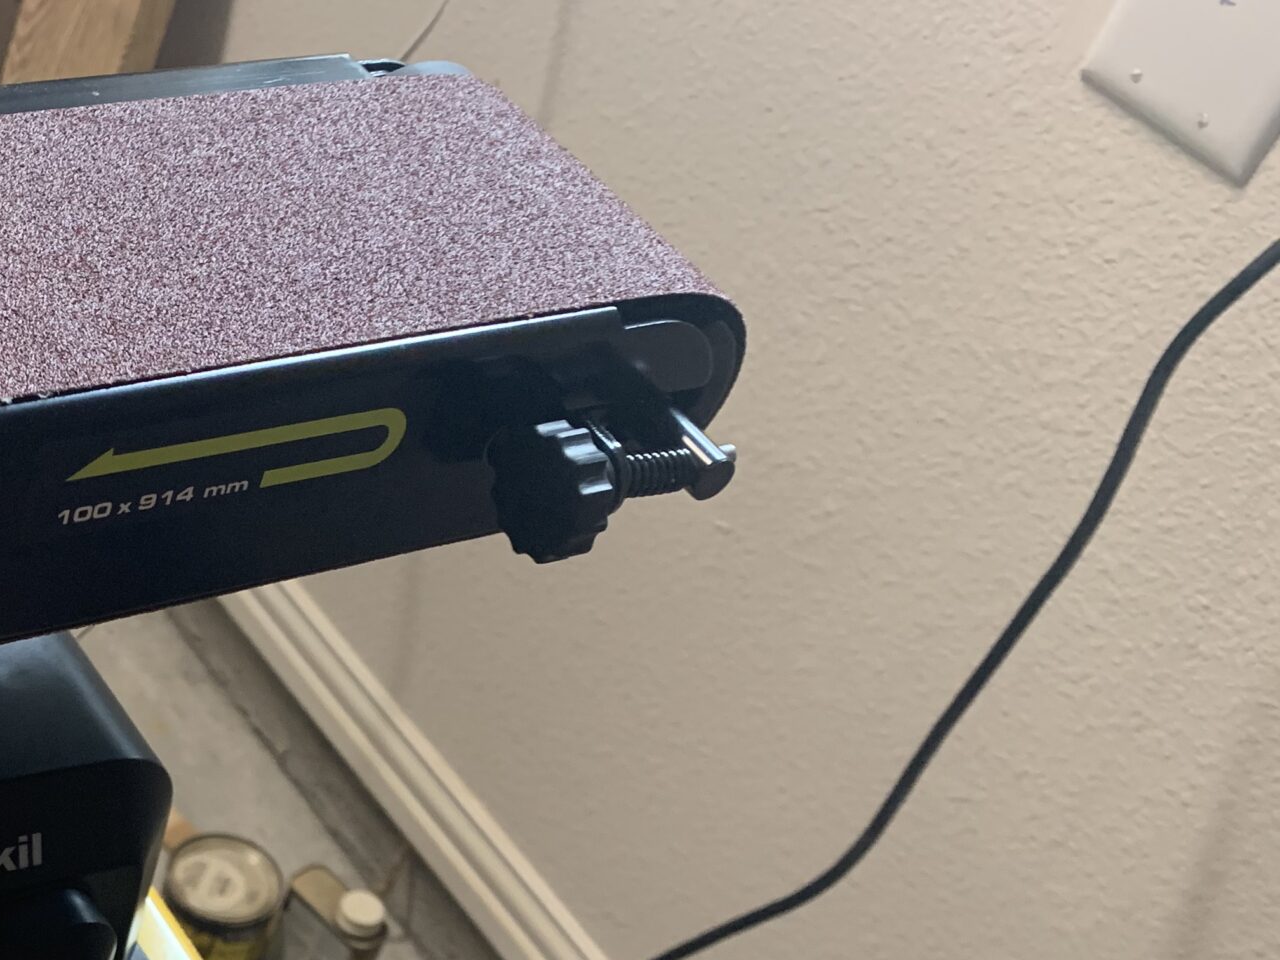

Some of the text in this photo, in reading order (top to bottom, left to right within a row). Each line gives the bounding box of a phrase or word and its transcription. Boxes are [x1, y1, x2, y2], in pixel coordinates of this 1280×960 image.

[57, 479, 249, 525] 100 x 914 mm
